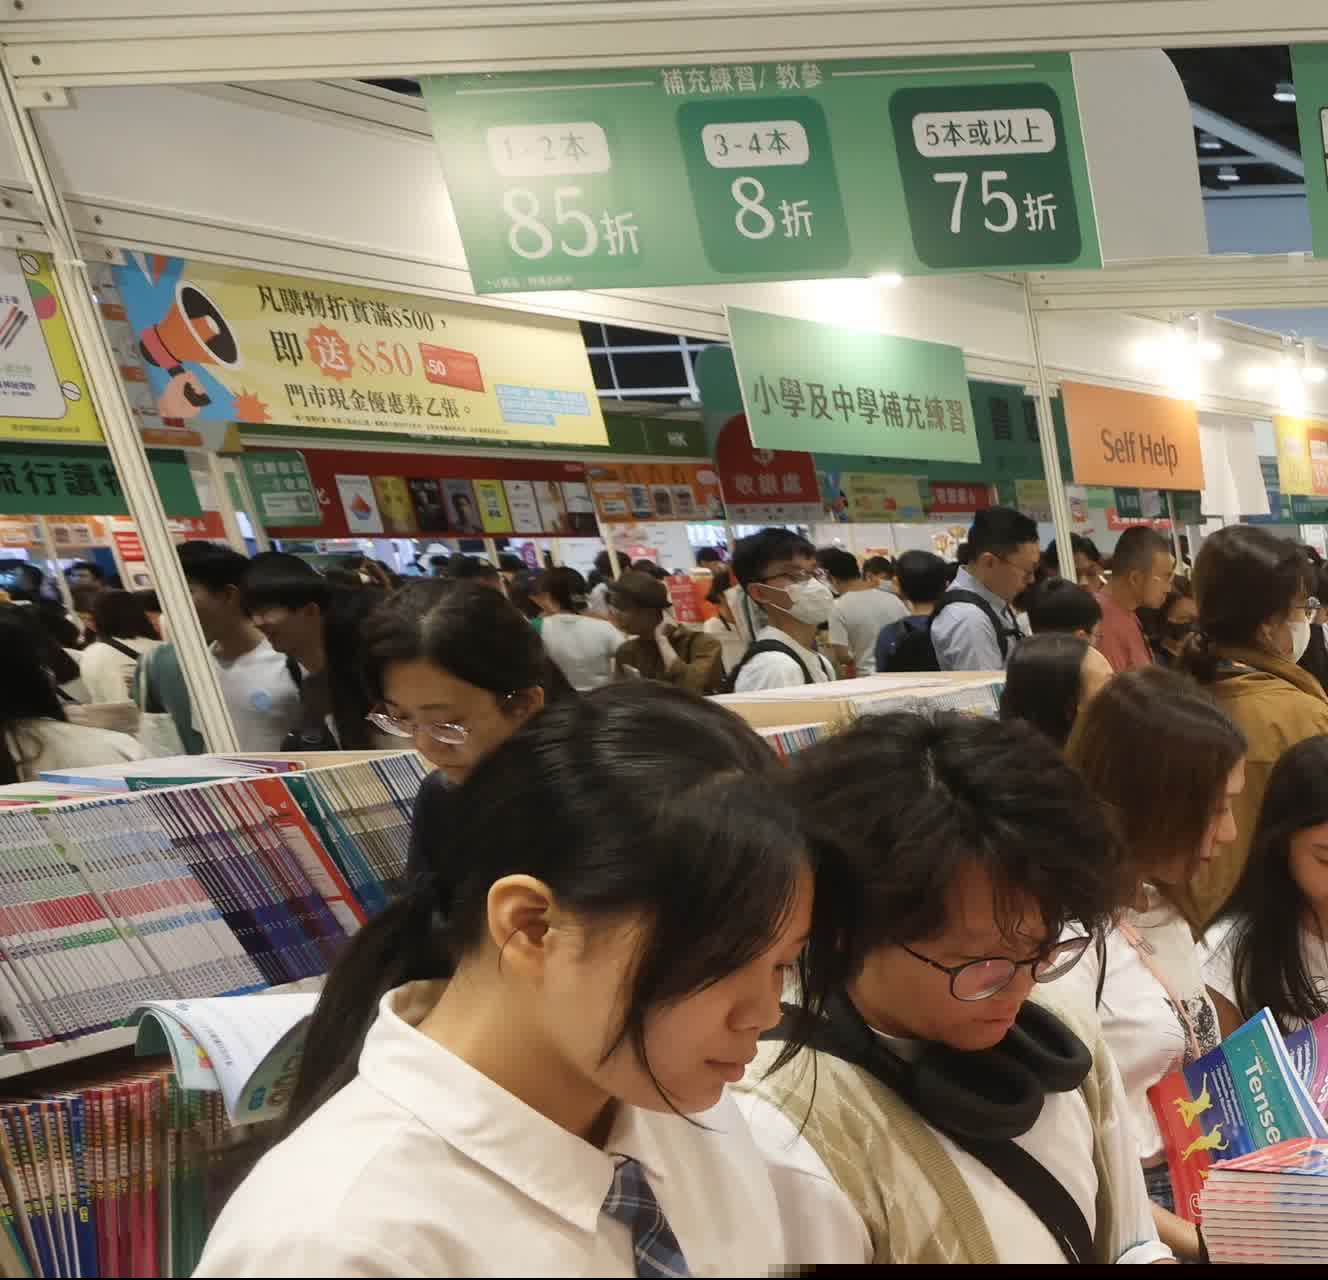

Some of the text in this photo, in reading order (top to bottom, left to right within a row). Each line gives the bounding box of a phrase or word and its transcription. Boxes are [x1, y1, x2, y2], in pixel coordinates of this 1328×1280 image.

[715, 129, 791, 157] 3-4本
[925, 118, 1045, 147] 5本或以上
[503, 186, 640, 260] 85折
[731, 176, 814, 240] 8折
[932, 170, 1058, 234] 75折
[754, 375, 967, 434] 小學及中學補充練習
[1101, 429, 1179, 476] Self Help
